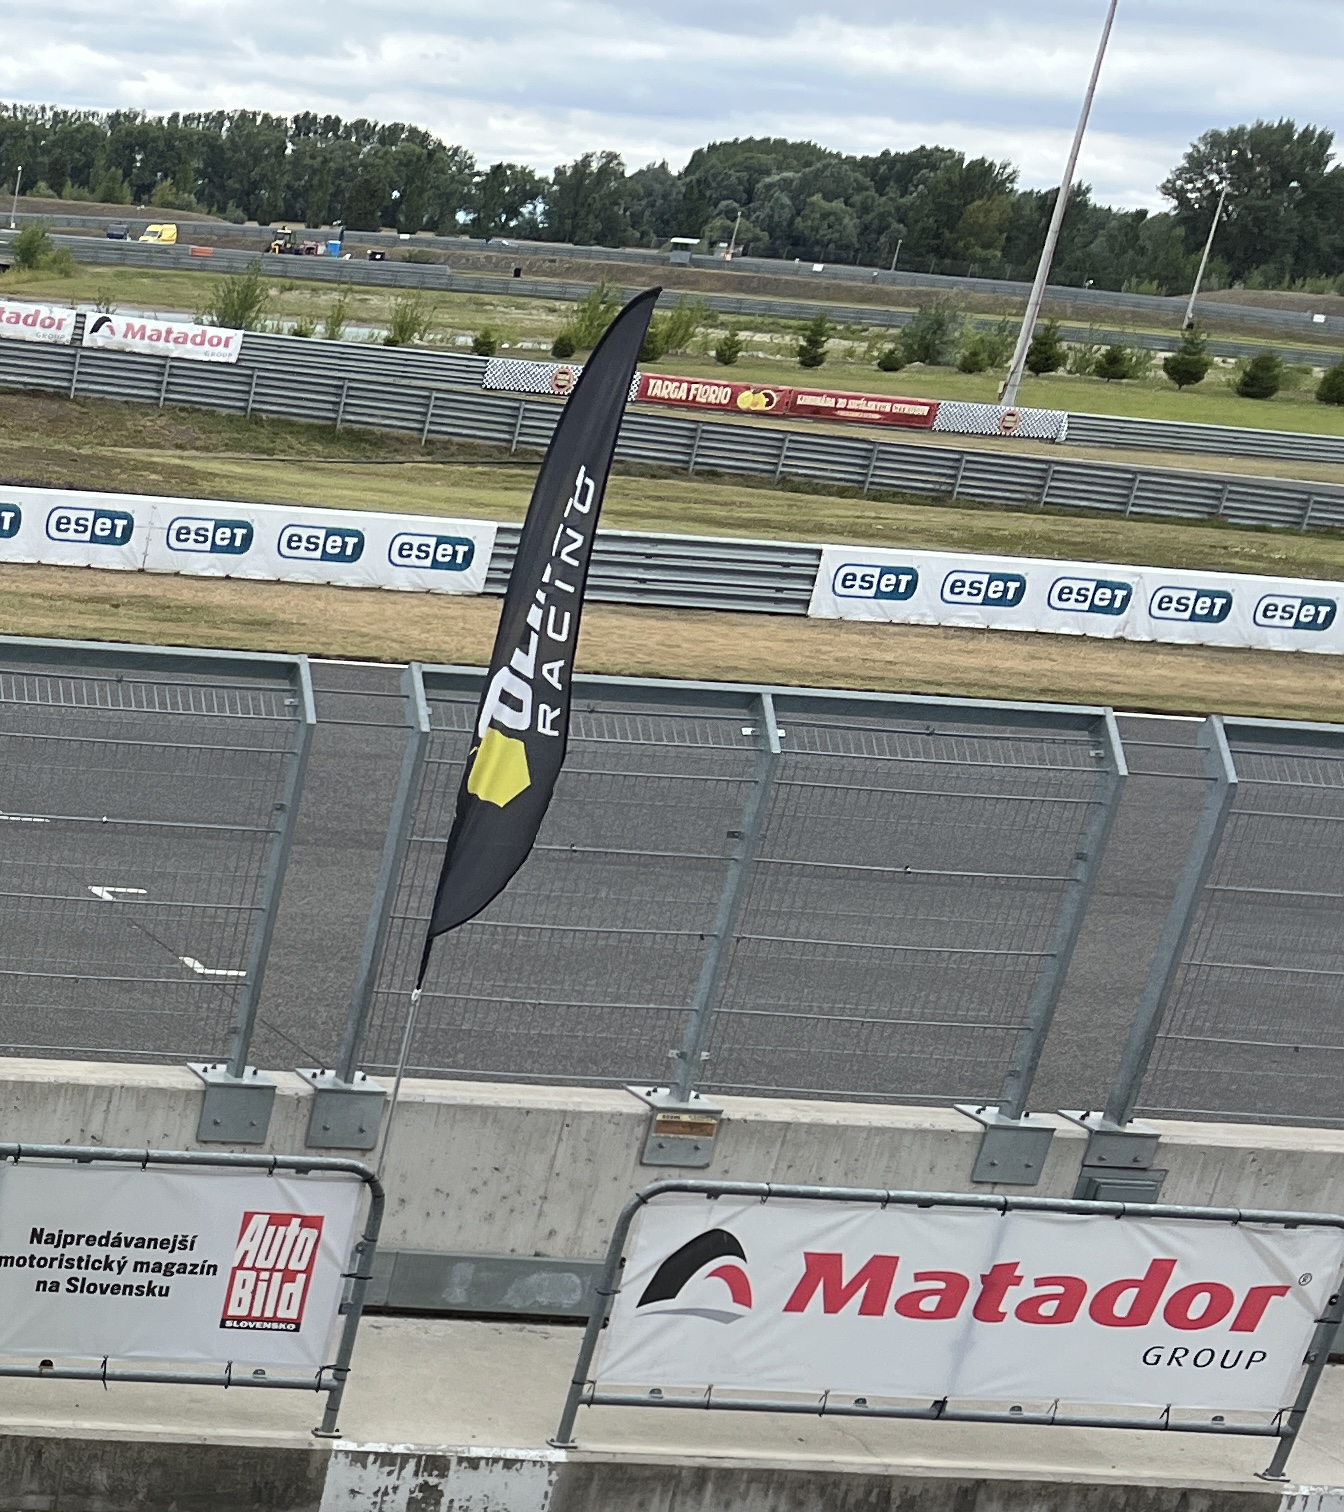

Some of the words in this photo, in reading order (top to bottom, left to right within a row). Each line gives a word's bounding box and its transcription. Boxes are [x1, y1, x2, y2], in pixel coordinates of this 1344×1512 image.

[123, 322, 233, 348] Matador
[647, 379, 688, 400] TARGA
[688, 383, 732, 404] FLORIO
[29, 1226, 198, 1253] Najpredávanejší
[232, 1214, 319, 1271] Auto
[133, 1258, 218, 1277] magazín
[35, 1277, 61, 1294] na
[65, 1277, 170, 1298] Slovensku
[226, 1268, 306, 1319] Bild
[782, 1251, 1293, 1334] Matador
[224, 1319, 296, 1331] SLOVENSKO
[1140, 1345, 1268, 1372] GROUP
